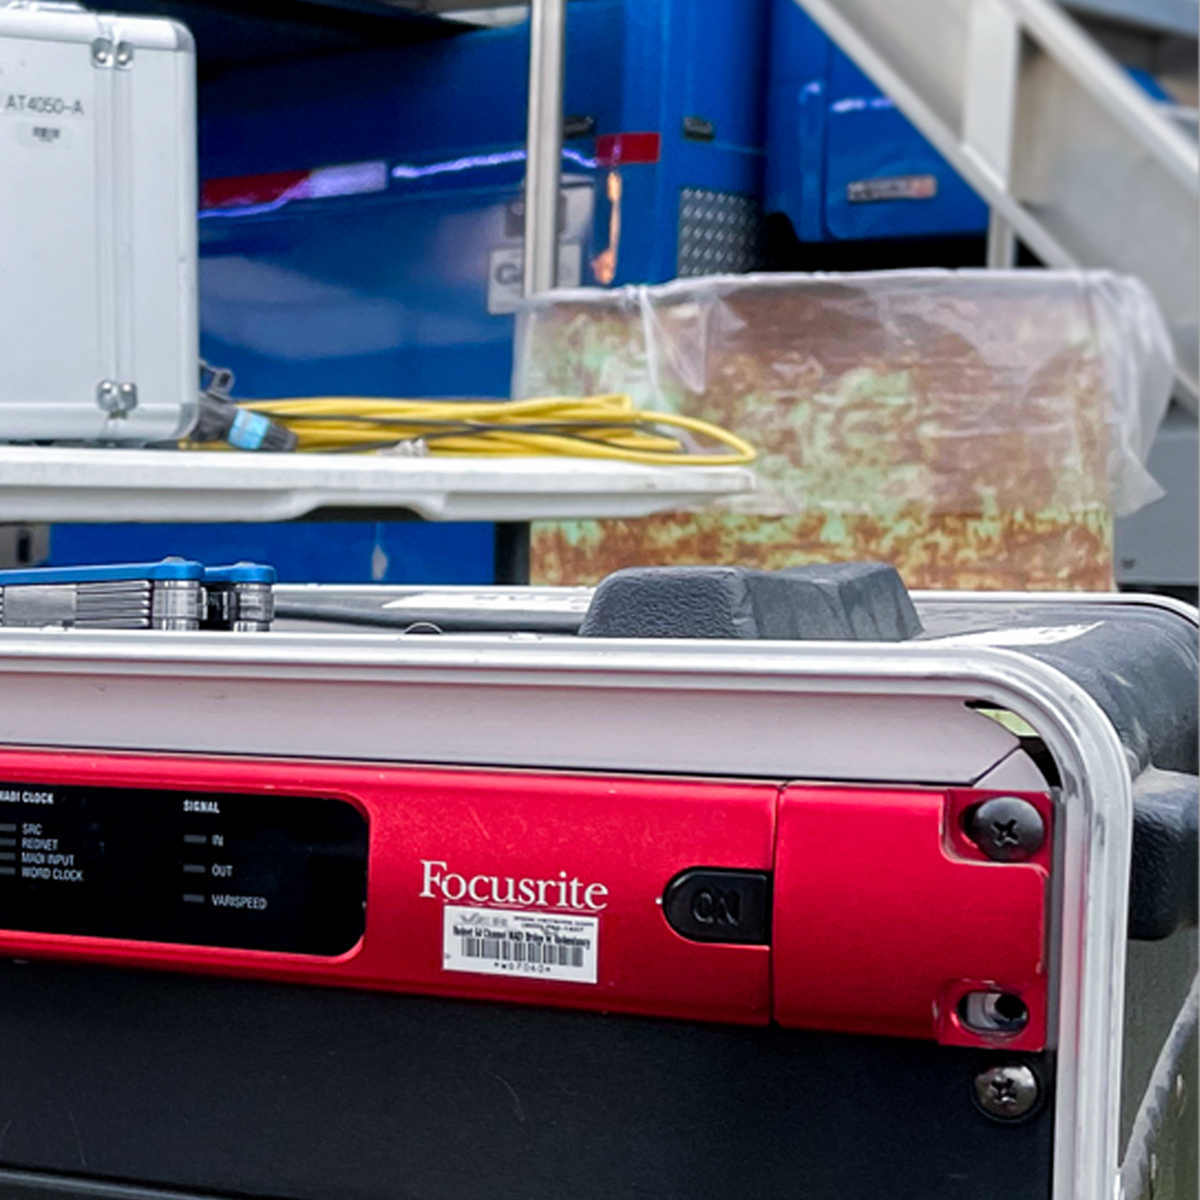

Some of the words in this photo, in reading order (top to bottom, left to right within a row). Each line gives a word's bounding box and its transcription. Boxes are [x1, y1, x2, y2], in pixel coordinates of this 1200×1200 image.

[5, 93, 85, 116] AT4050-A
[22, 791, 54, 805] CLOCK
[183, 800, 220, 814] SIGNAL
[211, 865, 233, 878] OUT
[419, 859, 608, 911] Focusrite
[691, 888, 742, 926] ON
